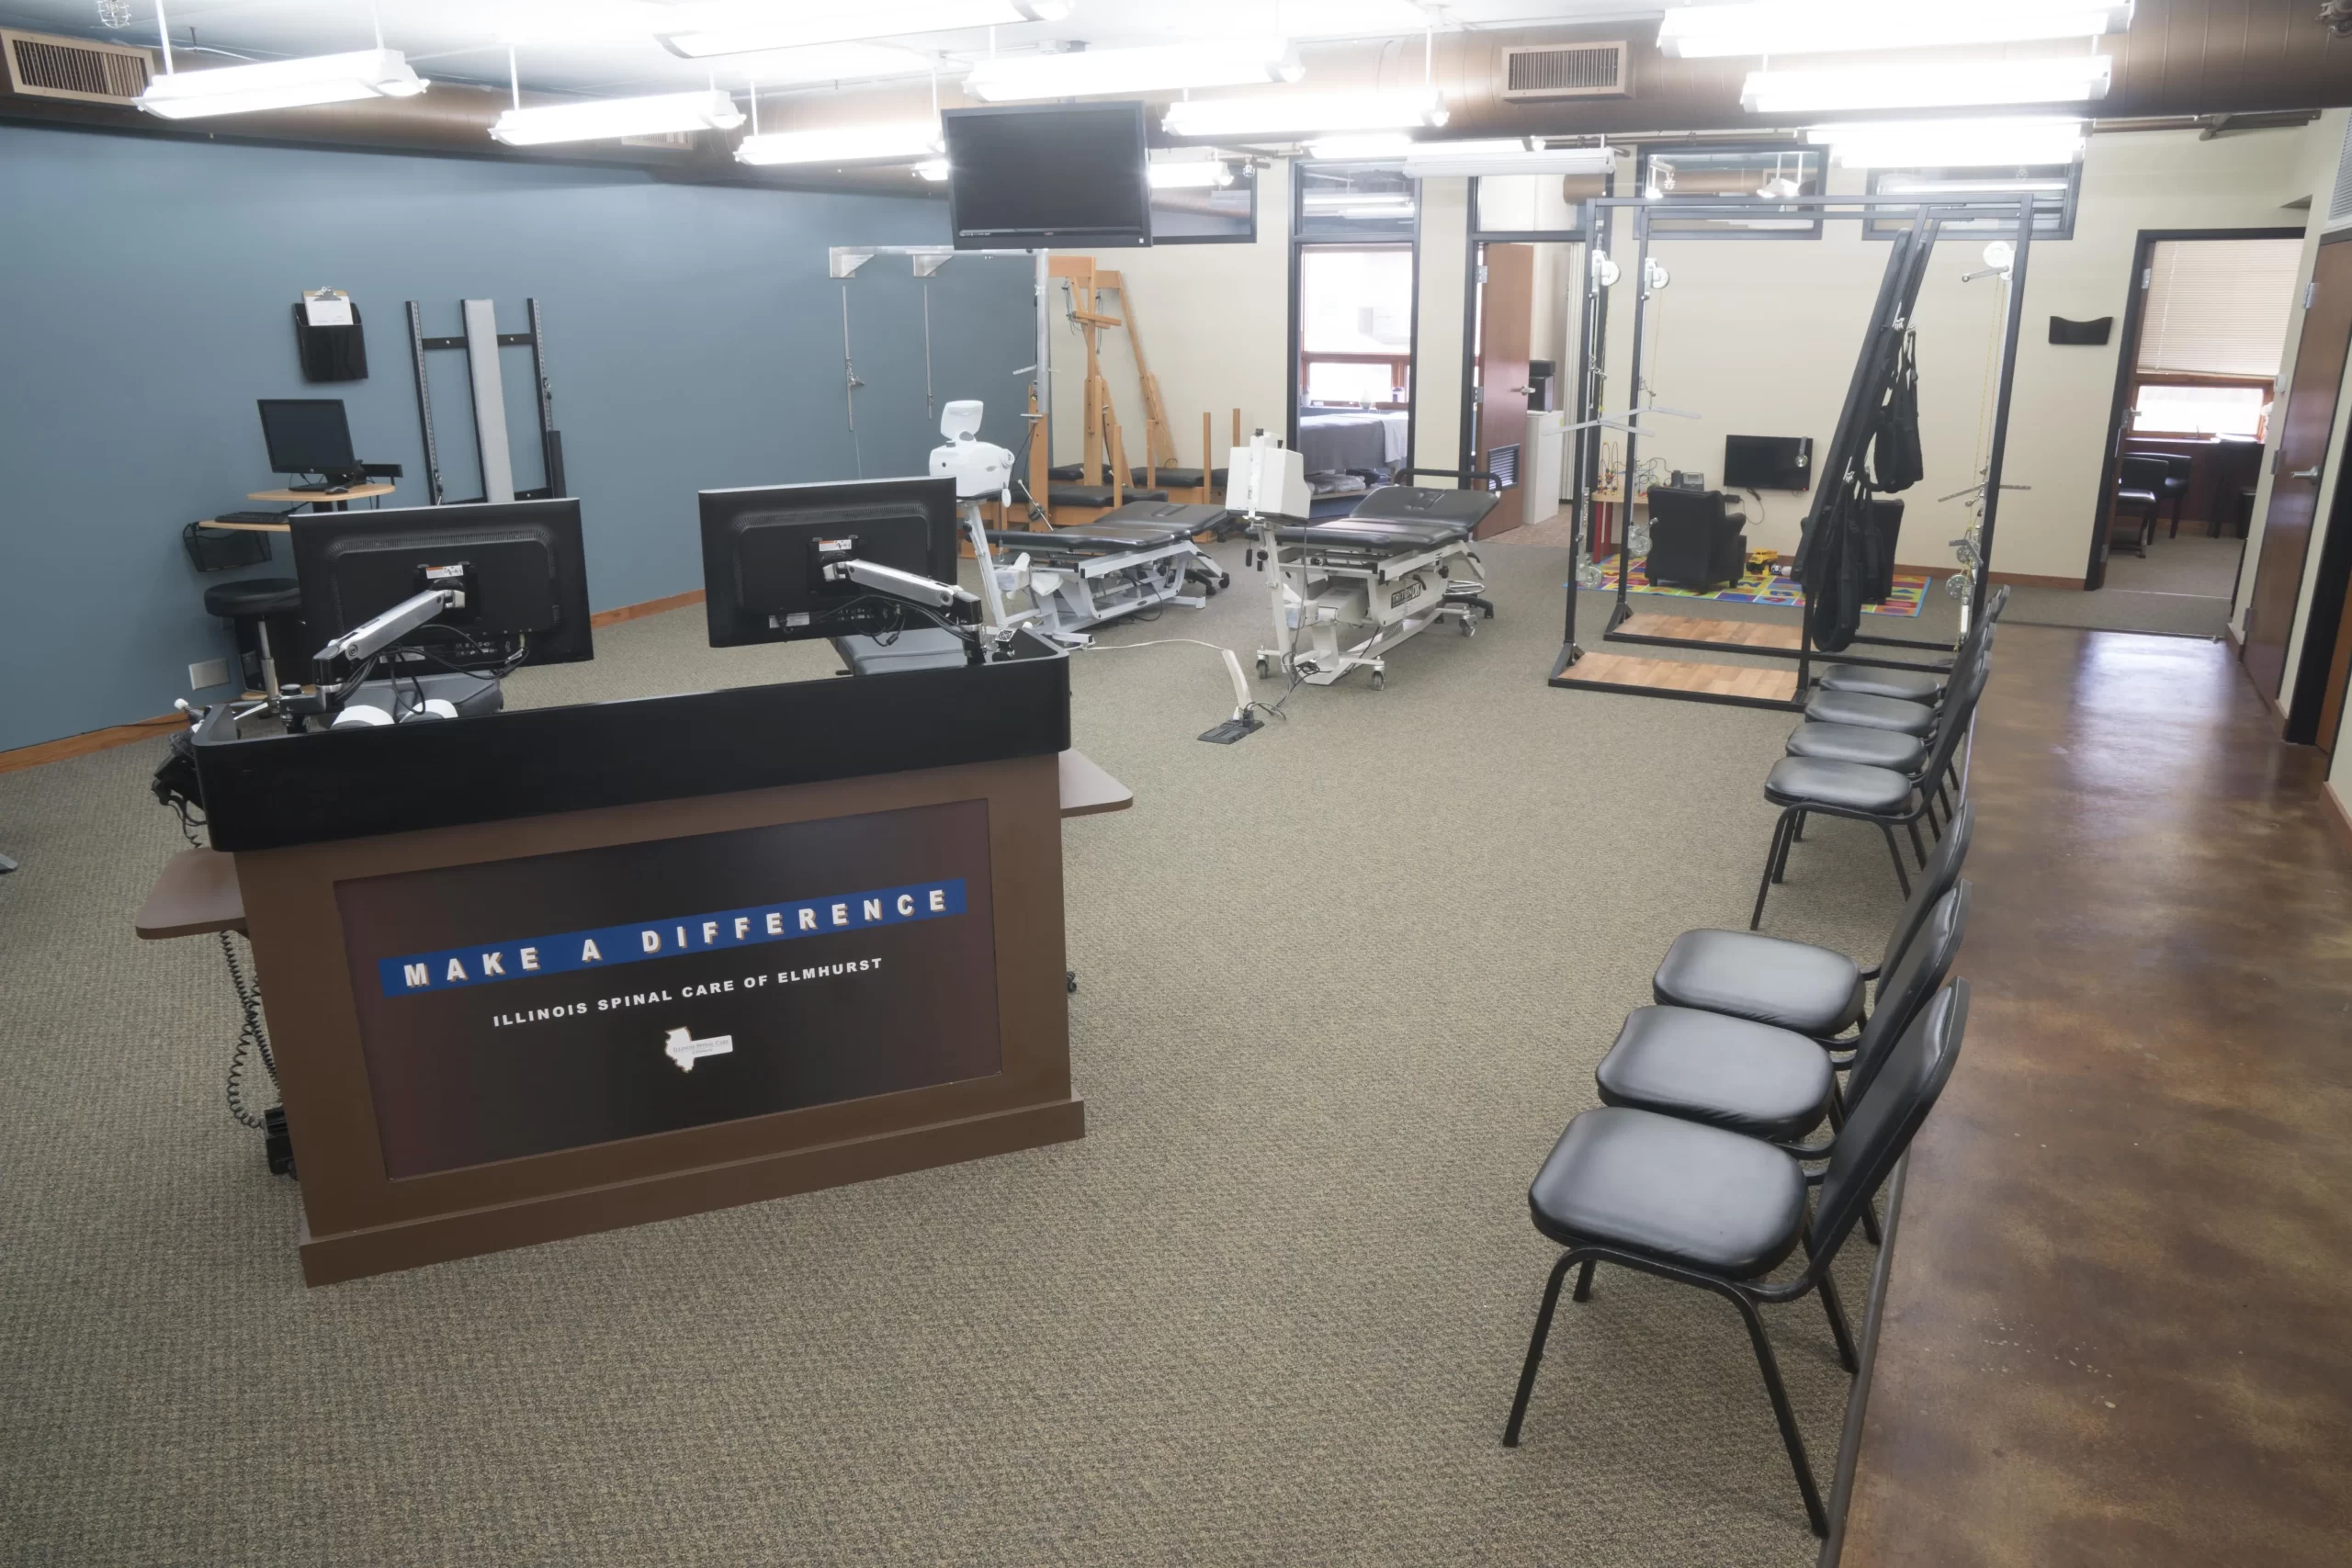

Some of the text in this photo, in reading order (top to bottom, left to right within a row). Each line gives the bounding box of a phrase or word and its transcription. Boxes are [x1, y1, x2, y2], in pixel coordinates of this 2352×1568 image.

[404, 890, 945, 988] MAKE A DIFFERENCE
[493, 958, 882, 1027] ILLINOIS SPINAL CARE OF ELMHURST
